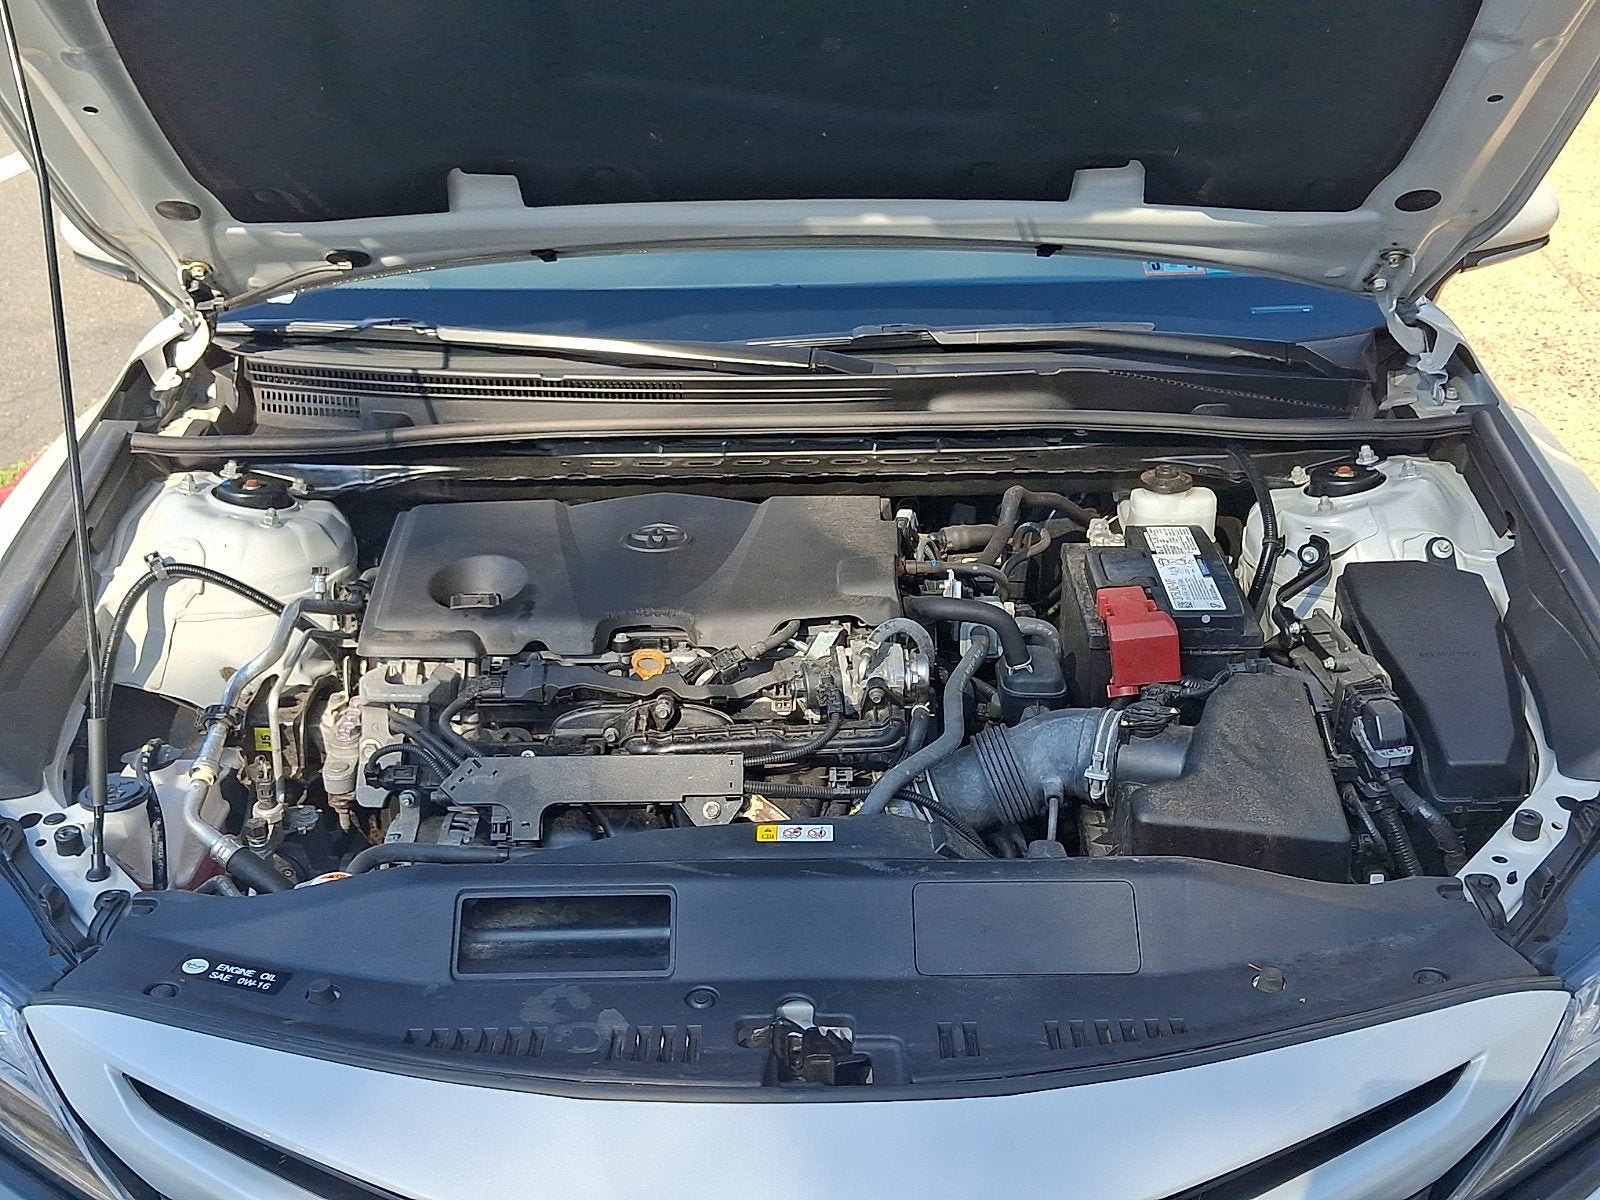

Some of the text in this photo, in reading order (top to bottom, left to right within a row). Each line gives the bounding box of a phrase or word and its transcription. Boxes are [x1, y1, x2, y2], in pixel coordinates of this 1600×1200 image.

[208, 971, 271, 990] SAE 0W-16
[215, 963, 277, 982] ENGINE OIL
